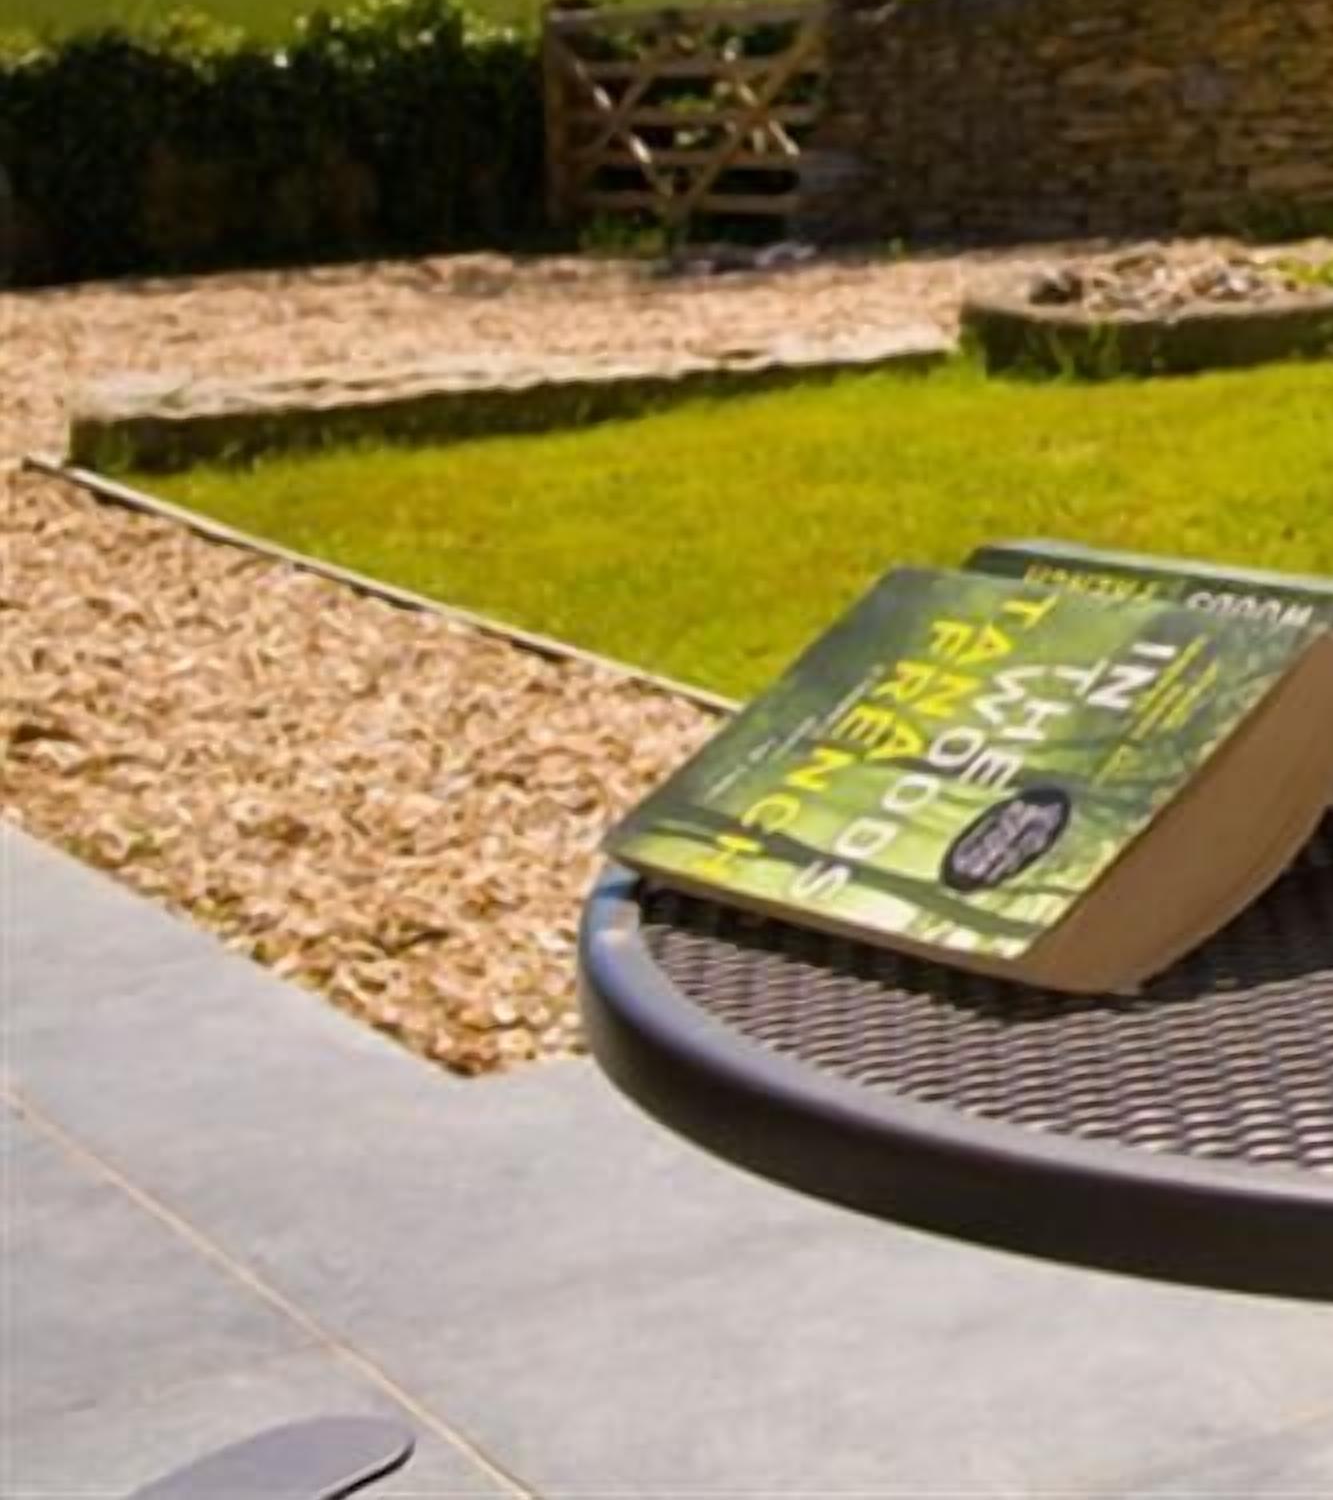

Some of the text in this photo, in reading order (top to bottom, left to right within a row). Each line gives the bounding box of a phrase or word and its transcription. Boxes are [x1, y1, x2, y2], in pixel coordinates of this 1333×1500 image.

[690, 619, 975, 886] FRENCH
[865, 594, 1058, 761] TANA
[958, 656, 1111, 798] THE
[1086, 642, 1179, 710] IN
[790, 664, 1049, 904] WOODS
